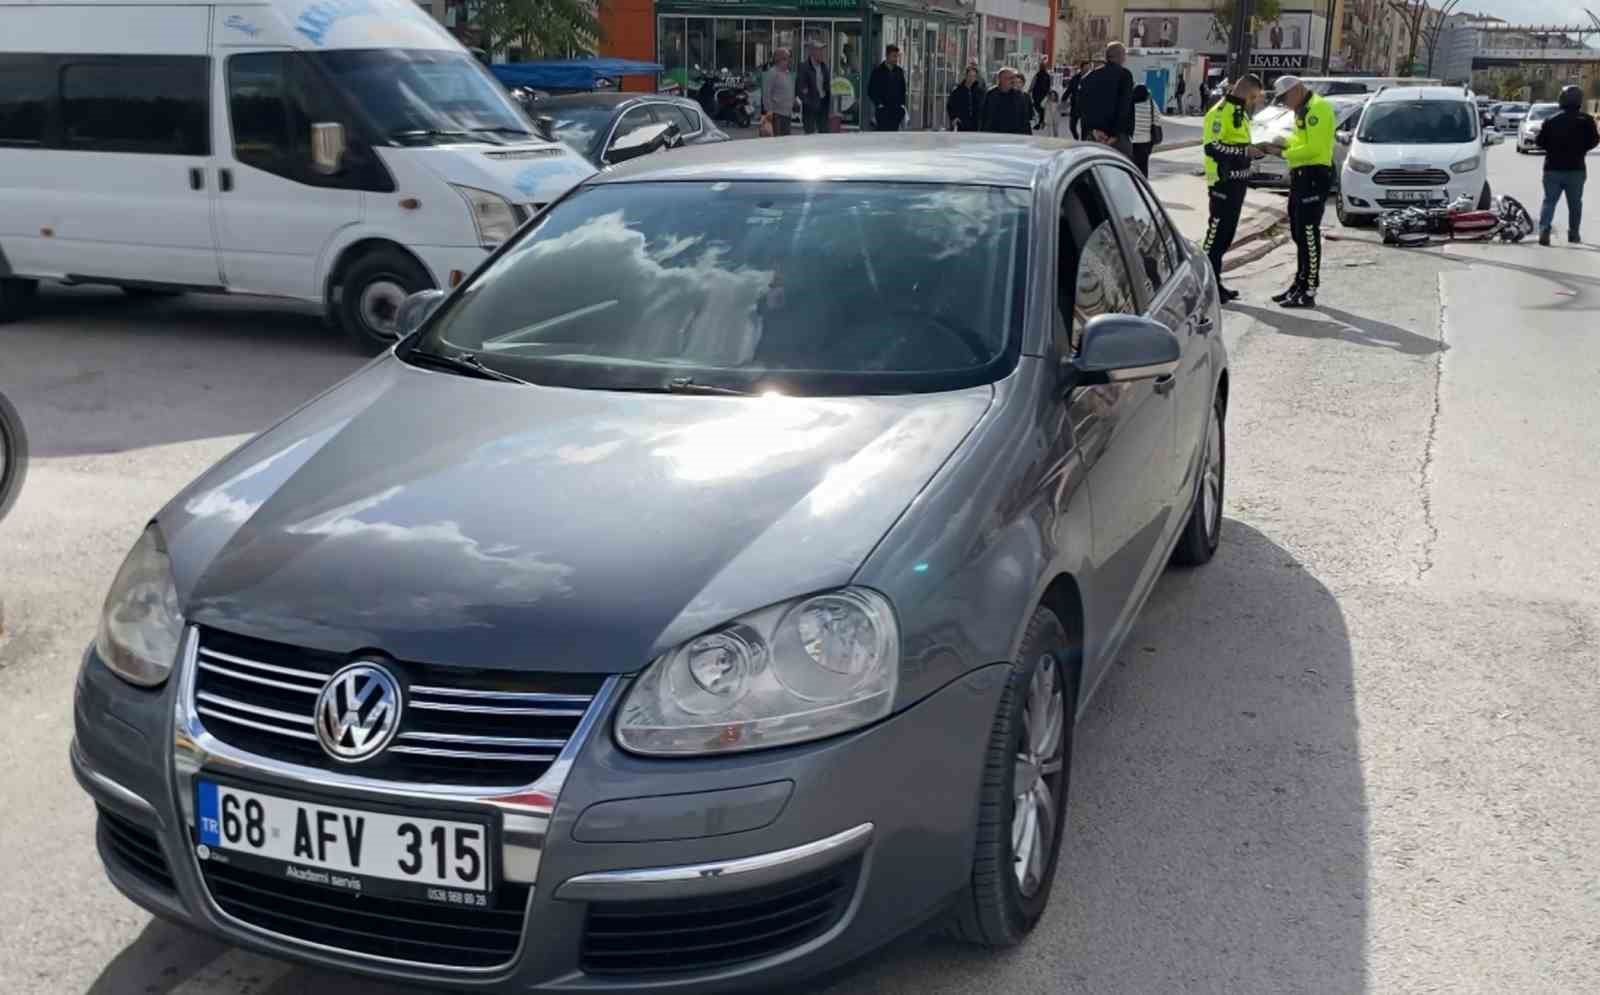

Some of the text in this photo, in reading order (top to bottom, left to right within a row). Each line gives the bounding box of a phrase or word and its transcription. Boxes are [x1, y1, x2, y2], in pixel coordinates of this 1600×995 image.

[317, 664, 399, 759] VW
[201, 816, 218, 834] TR
[222, 793, 481, 883] 68 AFV 315
[286, 865, 329, 884] Akademi
